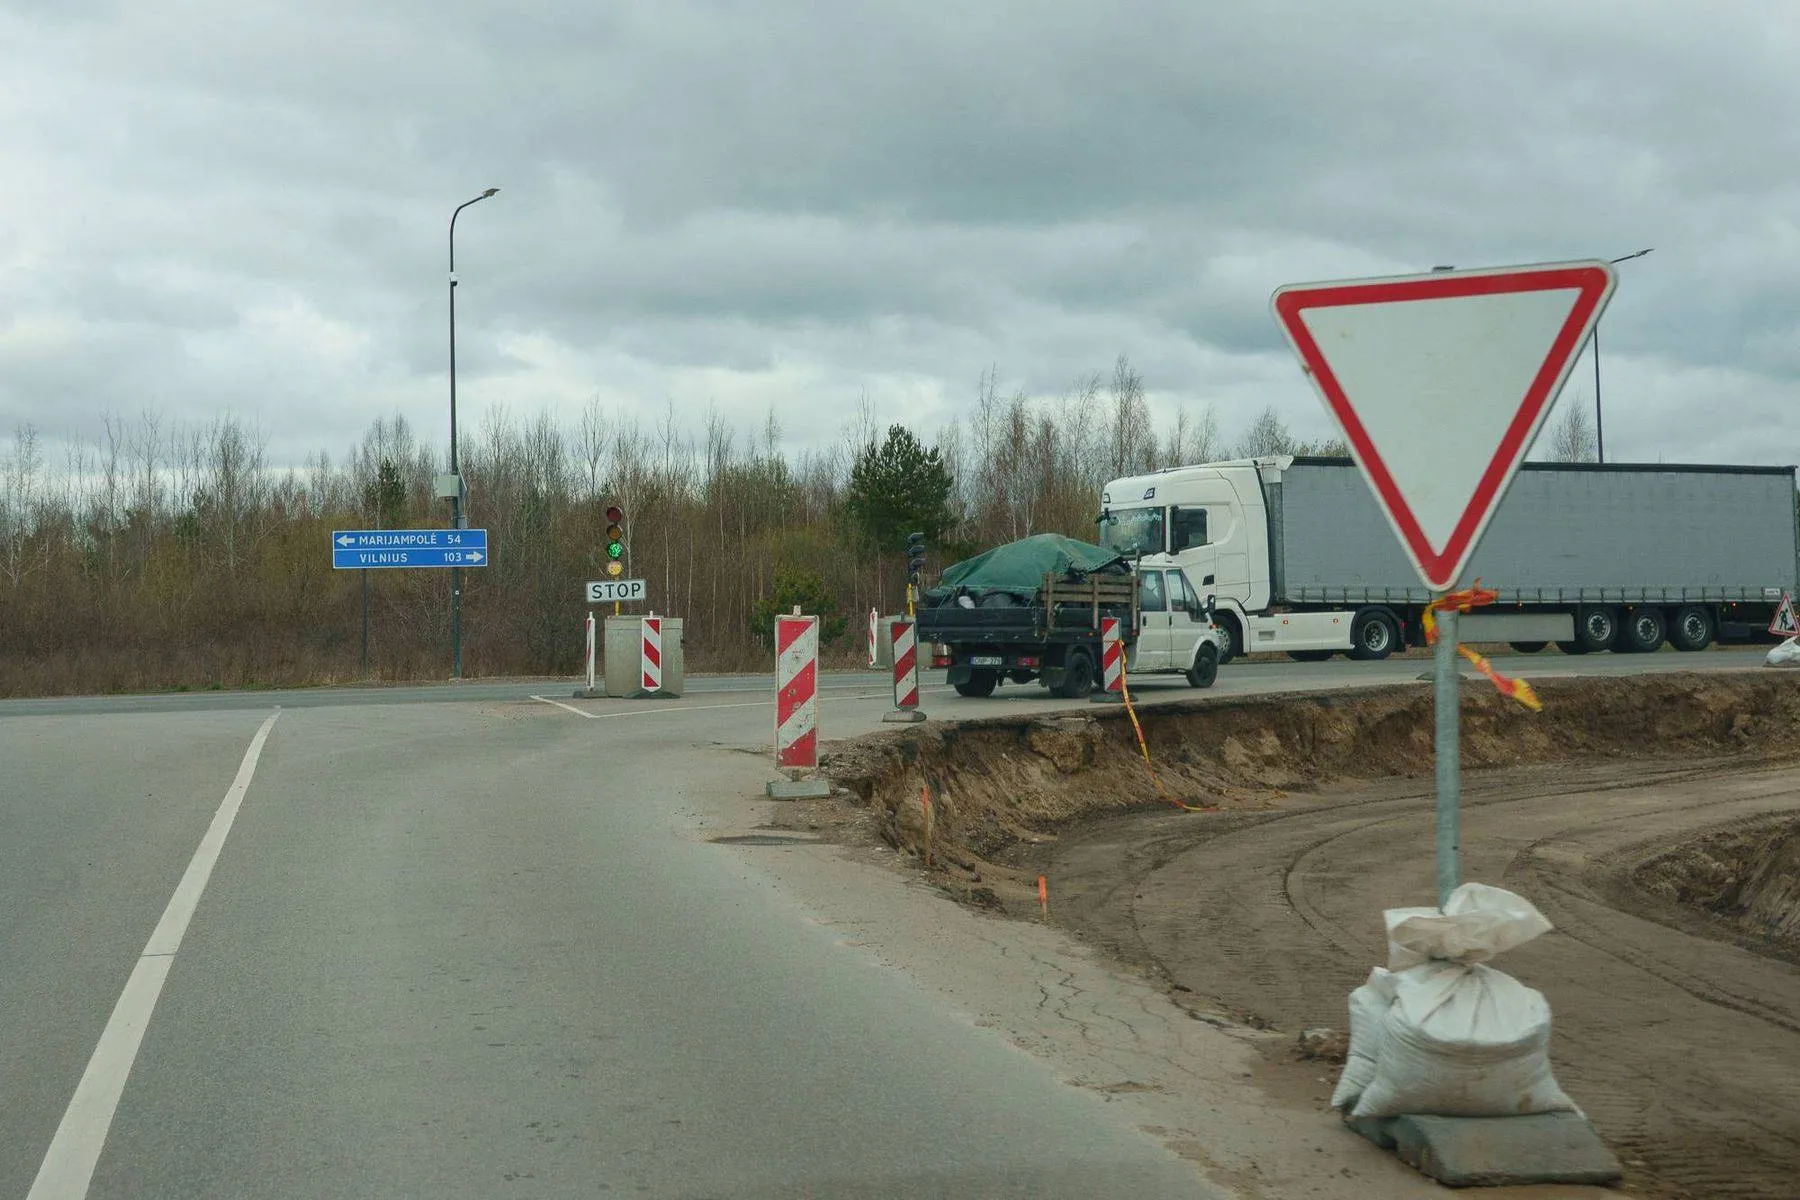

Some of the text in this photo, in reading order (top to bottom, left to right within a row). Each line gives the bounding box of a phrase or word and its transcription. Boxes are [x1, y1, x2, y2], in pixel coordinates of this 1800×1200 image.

[447, 534, 462, 544] 54
[359, 552, 462, 563] VILNIUS 103
[592, 583, 641, 599] STOP
